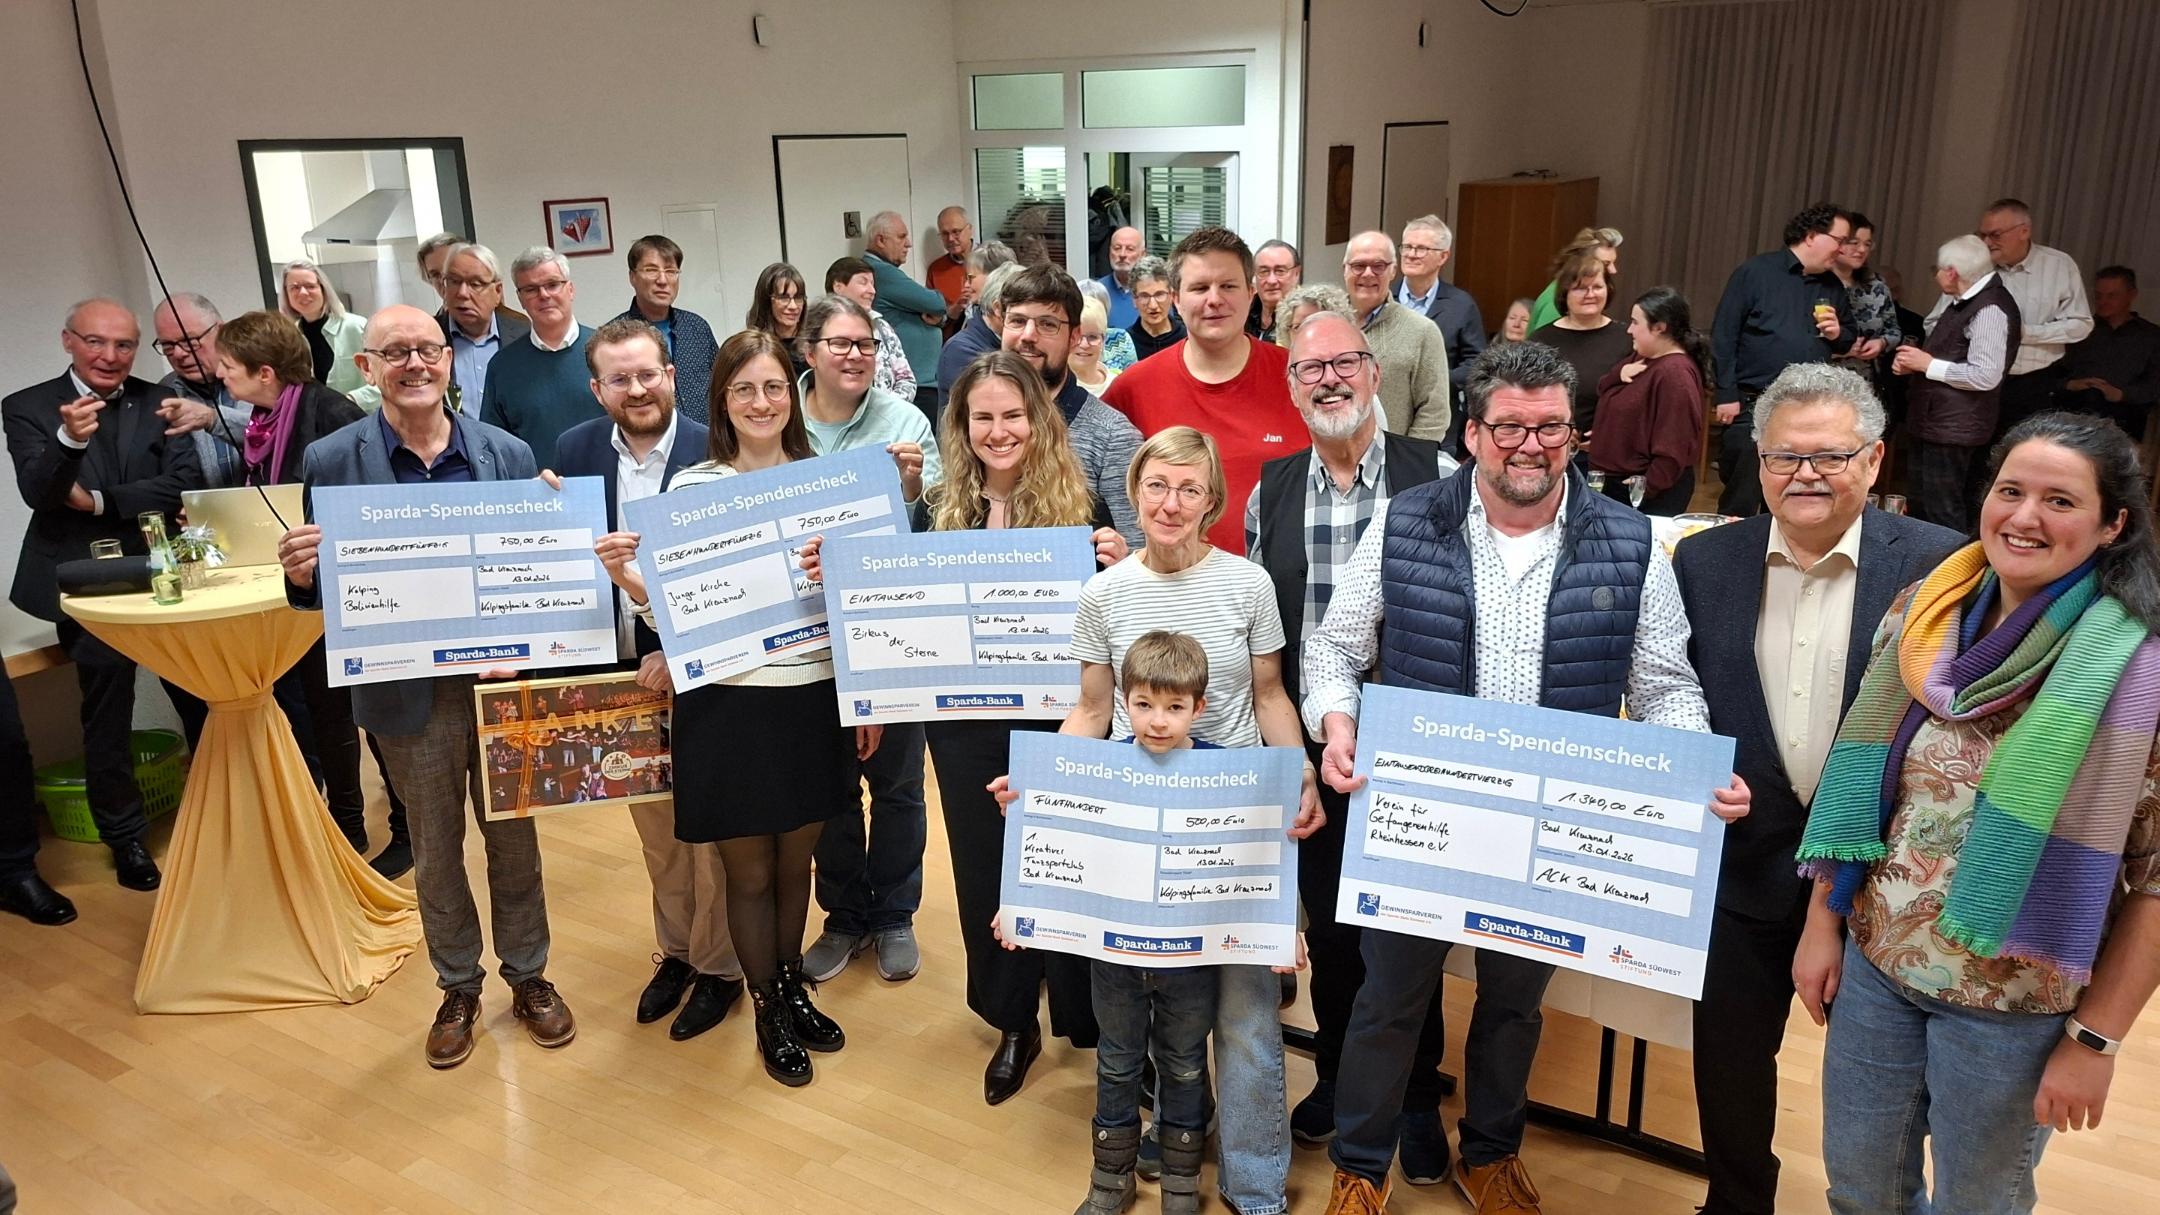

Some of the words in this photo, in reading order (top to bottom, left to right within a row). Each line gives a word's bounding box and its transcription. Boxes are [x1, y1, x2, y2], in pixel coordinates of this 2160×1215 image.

[1263, 433, 1283, 443] Jan
[670, 470, 858, 528] Sparda-Spendenscheck
[360, 498, 564, 524] Sparda-Spendenscheck
[797, 515, 836, 531] 750,00
[838, 510, 859, 521] Euro
[500, 536, 534, 546] 750,00
[537, 536, 558, 545] Euro
[790, 548, 800, 556] Ba
[861, 548, 1053, 573] Sparda-Spendenscheck
[478, 565, 494, 573] Bad
[347, 584, 380, 596] Kolping
[668, 591, 696, 607] Junge
[700, 579, 731, 593] Kirche
[797, 580, 823, 591] Kolping
[681, 604, 700, 615] Bad
[704, 588, 747, 609] Kreuznach
[849, 590, 926, 605] EINTAUSEND
[983, 588, 1029, 600] 1.000,00
[1033, 589, 1060, 598] EURO
[535, 598, 550, 609] Bad
[973, 615, 990, 624] Bad
[774, 626, 829, 647] Sparda-Ba
[851, 627, 889, 640] Zirkus
[889, 636, 905, 647] der
[445, 647, 519, 661] Sparda-Bank
[904, 646, 939, 658] Sterne
[1031, 651, 1048, 661] Bad
[946, 695, 1014, 707] Sparda-Bank
[545, 709, 655, 733] ANKE
[1411, 715, 1673, 774] Sparda-Spendenscheck
[1054, 756, 1259, 788] Sparda-Spendenscheck
[1033, 794, 1107, 814] FÜNFHUNDERT
[1376, 794, 1404, 811] Verein
[1410, 803, 1428, 817] für
[1558, 792, 1626, 811] 1.340,00
[1633, 804, 1665, 820] Euro
[1185, 817, 1220, 828] 500,00
[1223, 815, 1245, 825] Euro
[1369, 809, 1450, 838] Gefangenenhilfe
[1541, 820, 1560, 833] Bad
[1569, 827, 1613, 844] Kreuznach
[1370, 829, 1425, 848] Rheinhessen
[1427, 841, 1449, 852] e.V.
[1024, 843, 1064, 855] Kreativer
[1164, 846, 1182, 855] Bad
[1578, 843, 1633, 863] 13.01.2026
[1023, 856, 1085, 870] Tanzsportclub
[1023, 867, 1040, 878] Bad
[1215, 884, 1230, 894] Bad
[1233, 882, 1272, 893] Kreuznach
[1536, 868, 1571, 884] ACK
[1577, 876, 1597, 893] Bad
[1603, 882, 1650, 904] Kreuznach
[1380, 904, 1443, 920] GEWINNSPARVEREIN
[1478, 917, 1572, 948] Sparda-Bank
[1114, 936, 1192, 951] Sparda-Bank
[1620, 957, 1647, 969] SPARDA
[1648, 963, 1682, 977] SÜDWEST
[1620, 964, 1652, 976] STIFTUNG
